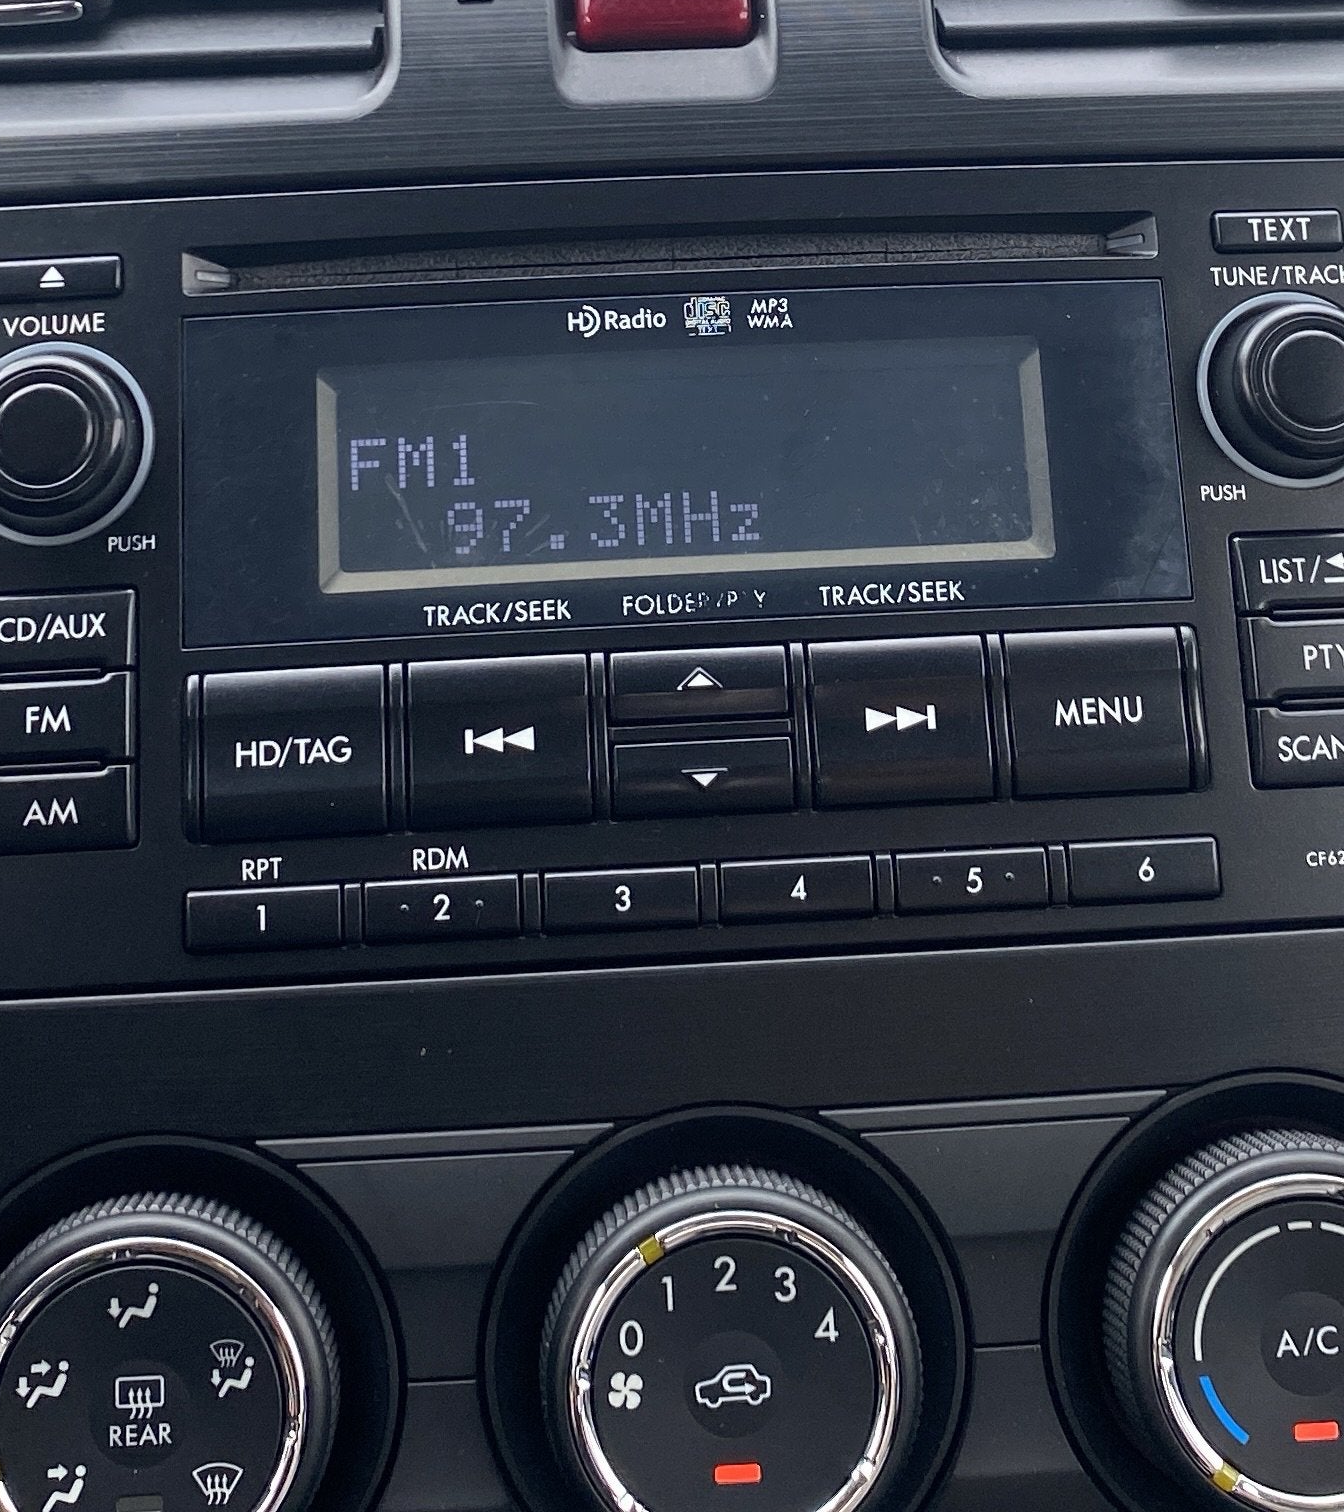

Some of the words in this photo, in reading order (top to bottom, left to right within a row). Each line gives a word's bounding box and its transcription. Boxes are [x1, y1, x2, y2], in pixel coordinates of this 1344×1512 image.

[1247, 217, 1311, 242] TEXT
[604, 307, 667, 331] Radio
[750, 297, 788, 315] MP3
[2, 312, 105, 337] VOLUME
[746, 313, 793, 329] WMA
[350, 434, 476, 491] FM1
[1200, 484, 1247, 502] PUSH
[446, 490, 761, 556] 97.3MHz
[107, 534, 156, 553] PUSH
[818, 580, 965, 606] TRACK/SEEK
[423, 599, 572, 629] TRACK/SEEK
[25, 705, 71, 734] FM
[1055, 695, 1143, 727] MENU
[235, 735, 352, 768] HD/TAG
[22, 797, 79, 827] AM
[241, 856, 283, 881] RPT
[412, 845, 469, 871] RDM
[1138, 856, 1155, 882] 6
[790, 875, 807, 901] 4
[966, 867, 983, 894] 5
[433, 893, 451, 921] 2
[615, 885, 631, 912] 3
[256, 904, 266, 931] 1
[713, 1255, 737, 1292] 2
[774, 1266, 797, 1303] 3
[661, 1275, 674, 1312] 1
[814, 1306, 839, 1343] 4
[619, 1320, 644, 1357] 0
[1276, 1325, 1339, 1358] A/C
[109, 1422, 172, 1447] REAR
